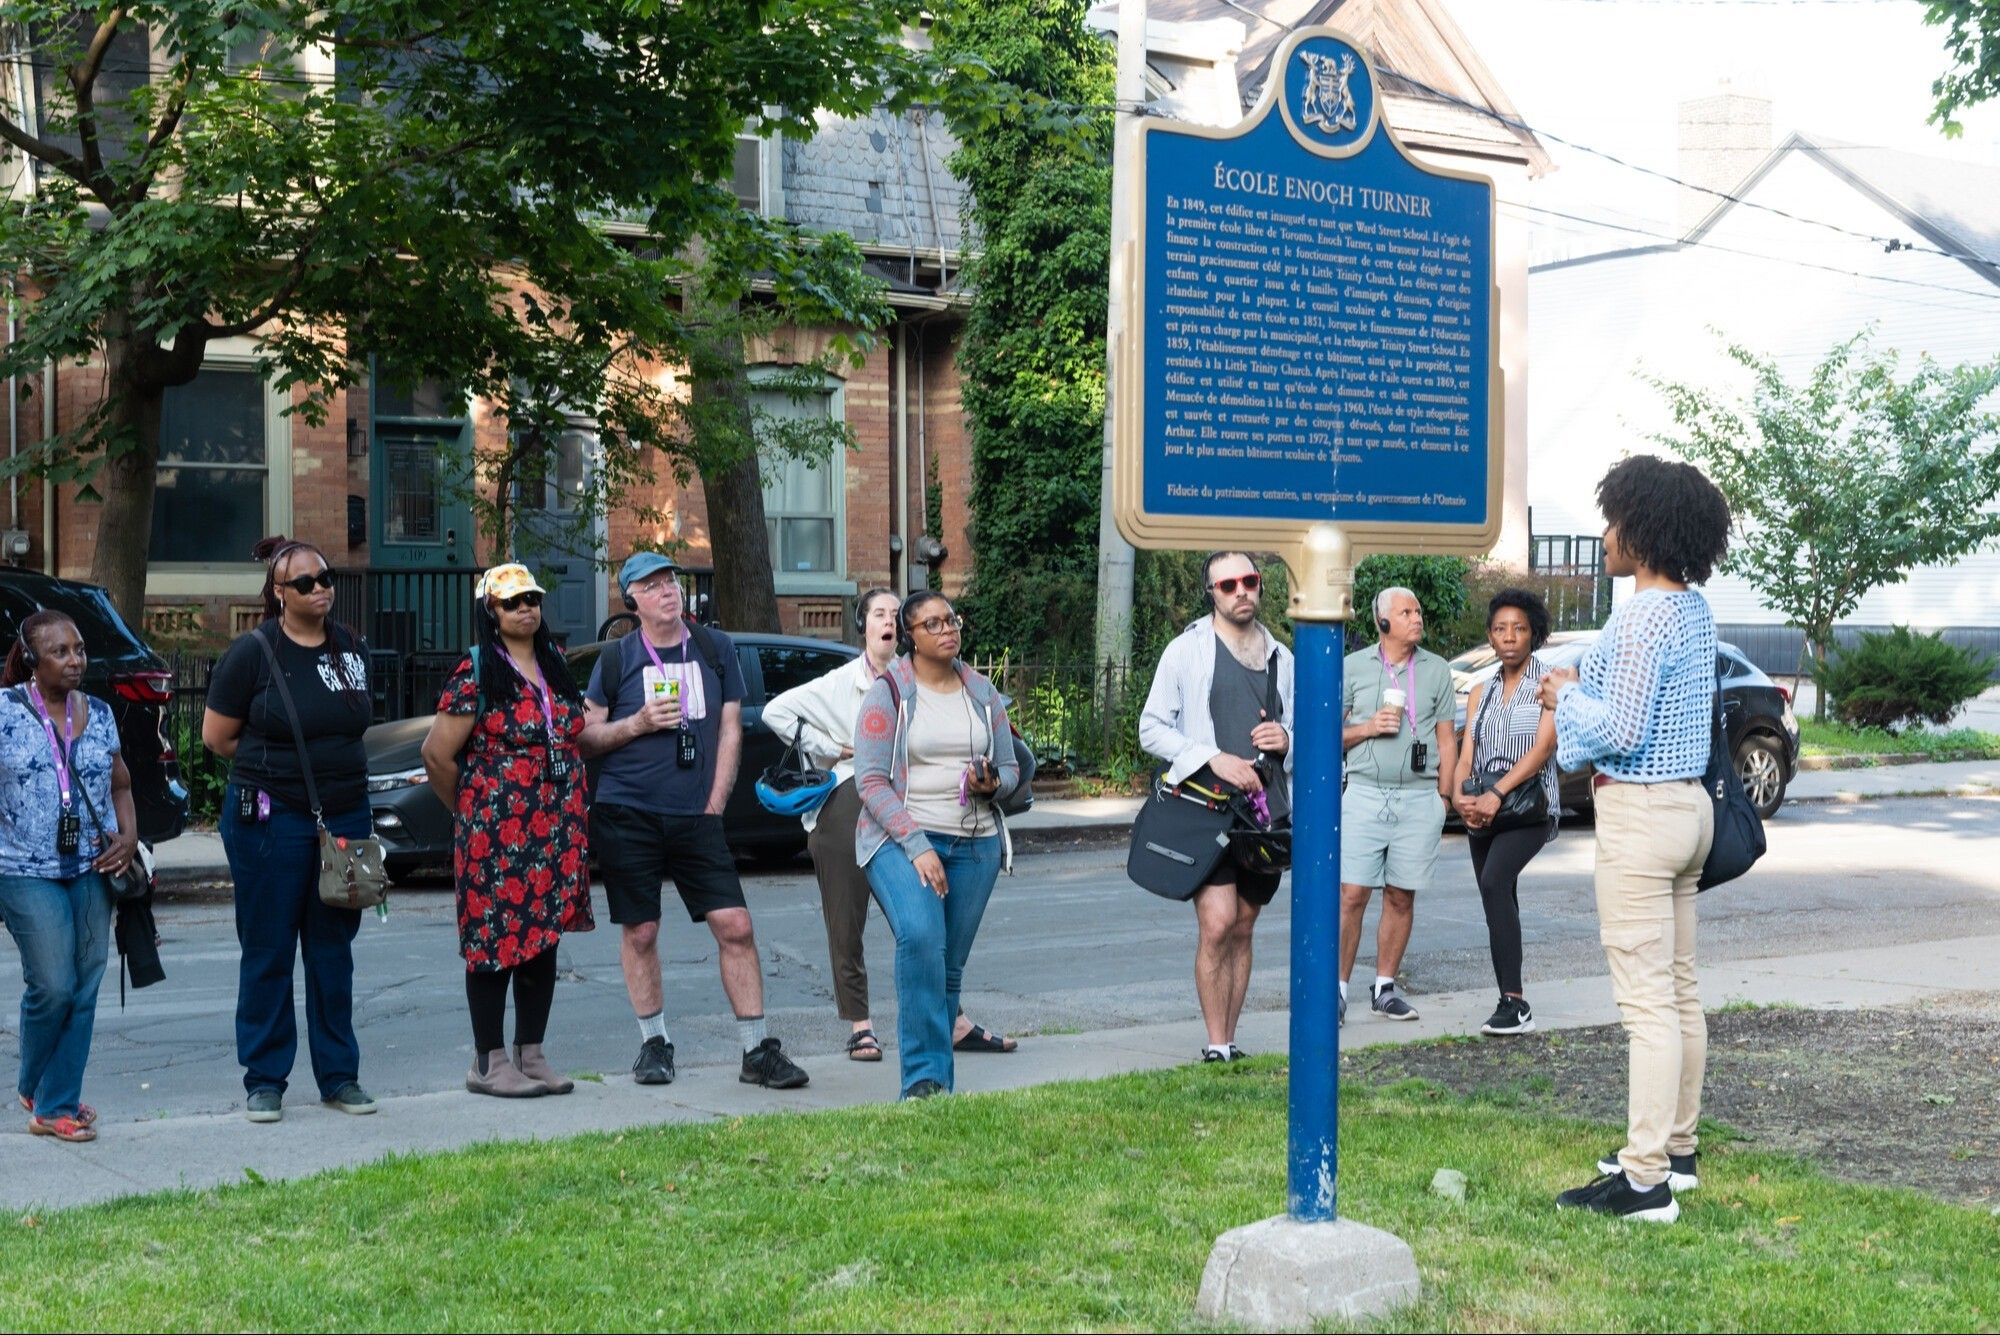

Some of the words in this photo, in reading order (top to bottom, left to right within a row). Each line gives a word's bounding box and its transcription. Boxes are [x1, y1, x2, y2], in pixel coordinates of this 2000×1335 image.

[1213, 161, 1279, 196] ÉCOLE
[1285, 178, 1353, 208] ENOCH
[1359, 188, 1432, 218] TURNER
[1166, 196, 1179, 208] En
[1183, 198, 1207, 214] 1849,
[1210, 205, 1222, 214] cet
[1225, 203, 1253, 218] édifice
[1256, 211, 1267, 220] est
[1270, 210, 1305, 226] inauguré
[1307, 218, 1318, 226] en
[1320, 218, 1335, 229] tant
[1356, 221, 1376, 234] Ward
[1378, 224, 1400, 237] Street
[1403, 228, 1429, 241] School.
[1461, 235, 1471, 246] de
[1166, 213, 1175, 225] la
[1178, 218, 1216, 230] première
[1219, 220, 1241, 234] école
[1245, 223, 1264, 236] libre
[1266, 226, 1276, 238] de
[1280, 228, 1313, 243] Toronto.
[1317, 233, 1342, 246] Enoch
[1345, 236, 1373, 252] Turner,
[1388, 241, 1419, 256] brasseur
[1166, 230, 1198, 245] finance
[1203, 234, 1211, 247] la
[1215, 240, 1267, 254] construction
[1271, 246, 1280, 255] et
[1296, 246, 1357, 264] fonctionnement
[1361, 254, 1370, 266] de
[1374, 259, 1393, 268] cette
[1397, 259, 1416, 271] école
[1166, 251, 1196, 263] terrain
[1199, 254, 1258, 270] gracieusement
[1262, 260, 1280, 272] cédé
[1284, 265, 1297, 276] par
[1301, 264, 1308, 275] la
[1312, 266, 1332, 278] Little
[1336, 268, 1362, 284] Trinity
[1365, 272, 1396, 285] Church.
[1400, 276, 1412, 287] Les
[1415, 277, 1437, 290] élèves
[1166, 267, 1199, 280] enfants
[1205, 270, 1217, 282] du
[1224, 275, 1258, 287] quartier
[1264, 277, 1284, 290] issus
[1290, 279, 1300, 291] de
[1306, 281, 1338, 295] familles
[1344, 285, 1387, 302] d'immigrés
[1166, 283, 1208, 299] irlandaise
[1215, 292, 1235, 303] pour
[1242, 291, 1250, 303] la
[1256, 293, 1289, 308] plupart.
[1296, 297, 1306, 308] Le
[1312, 301, 1339, 312] conseil
[1345, 303, 1375, 315] scolaire
[1381, 305, 1391, 317] de
[1396, 308, 1427, 321] Toronto
[1165, 320, 1178, 330] est
[1181, 320, 1198, 333] pris
[1200, 324, 1211, 333] en
[1213, 322, 1241, 338] charge
[1244, 328, 1257, 339] par
[1260, 326, 1267, 338] la
[1334, 333, 1341, 344] la
[1381, 338, 1405, 353] Trinity
[1408, 340, 1430, 352] Street
[1431, 343, 1457, 355] School.
[1166, 304, 1225, 317] responsabilité
[1228, 306, 1238, 319] de
[1242, 311, 1262, 321] cette
[1265, 310, 1286, 323] école
[1289, 316, 1299, 324] en
[1303, 314, 1325, 328] 1851,
[1328, 316, 1357, 332] lorsque
[1370, 320, 1416, 336] financement
[1418, 325, 1428, 337] de
[1431, 326, 1470, 341] l'éducation
[1166, 337, 1191, 351] 1859,
[1196, 339, 1256, 355] l'établissement
[1260, 344, 1300, 361] déménage
[1304, 351, 1311, 360] et
[1315, 353, 1323, 361] ce
[1327, 350, 1364, 366] bâtiment,
[1388, 359, 1402, 369] que
[1165, 355, 1202, 368] restitués
[1214, 357, 1221, 369] la
[1225, 359, 1247, 371] Little
[1250, 361, 1277, 376] Trinity
[1280, 363, 1312, 376] Church.
[1315, 366, 1338, 380] Après
[1341, 368, 1366, 382] l'ajout
[1368, 370, 1378, 381] de
[1381, 371, 1399, 383] l'aile
[1424, 378, 1433, 386] en
[1437, 376, 1456, 389] 1869,
[1165, 371, 1194, 385] édifice
[1200, 377, 1212, 386] est
[1217, 376, 1243, 388] utilisé
[1248, 381, 1258, 389] en
[1263, 381, 1279, 391] tant
[1284, 381, 1317, 394] qu'école
[1322, 383, 1333, 395] du
[1337, 384, 1375, 398] dimanche
[1379, 390, 1387, 398] et
[1165, 389, 1204, 403] Menacée
[1207, 392, 1217, 404] de
[1220, 393, 1265, 407] démolition
[1275, 396, 1283, 408] la
[1285, 397, 1296, 409] fin
[1299, 398, 1312, 410] des
[1344, 402, 1366, 415] 1960,
[1368, 403, 1393, 415] l'école
[1395, 405, 1404, 416] de
[1406, 406, 1423, 420] style
[1164, 409, 1177, 418] est
[1184, 409, 1212, 420] sauvée
[1218, 412, 1226, 421] et
[1232, 413, 1269, 424] restaurée
[1275, 417, 1288, 427] par
[1294, 414, 1307, 426] des
[1349, 418, 1383, 432] dévoués,
[1388, 420, 1405, 432] dont
[1410, 422, 1450, 435] l'architecte
[1455, 425, 1469, 436] Eric
[1165, 424, 1196, 437] Arthur.
[1201, 426, 1217, 438] Elle
[1221, 430, 1248, 440] rouvre
[1252, 432, 1264, 440] ses
[1267, 433, 1292, 444] portes
[1295, 435, 1305, 443] en
[1309, 432, 1331, 446] 1972,
[1347, 436, 1362, 446] tant
[1365, 438, 1379, 449] que
[1410, 440, 1418, 449] et
[1165, 442, 1183, 456] jour
[1186, 442, 1193, 454] le
[1196, 443, 1214, 457] plus
[1217, 445, 1244, 457] ancien
[1246, 445, 1282, 458] bâtiment
[1284, 448, 1315, 460] scolaire
[1317, 449, 1327, 460] de
[1329, 450, 1362, 462] Toronto.
[1167, 483, 1198, 495] Fiducie
[1201, 484, 1212, 496] du
[1215, 486, 1260, 499] patrimoine
[1422, 493, 1431, 503] de
[1433, 493, 1466, 505] l'Ontario
